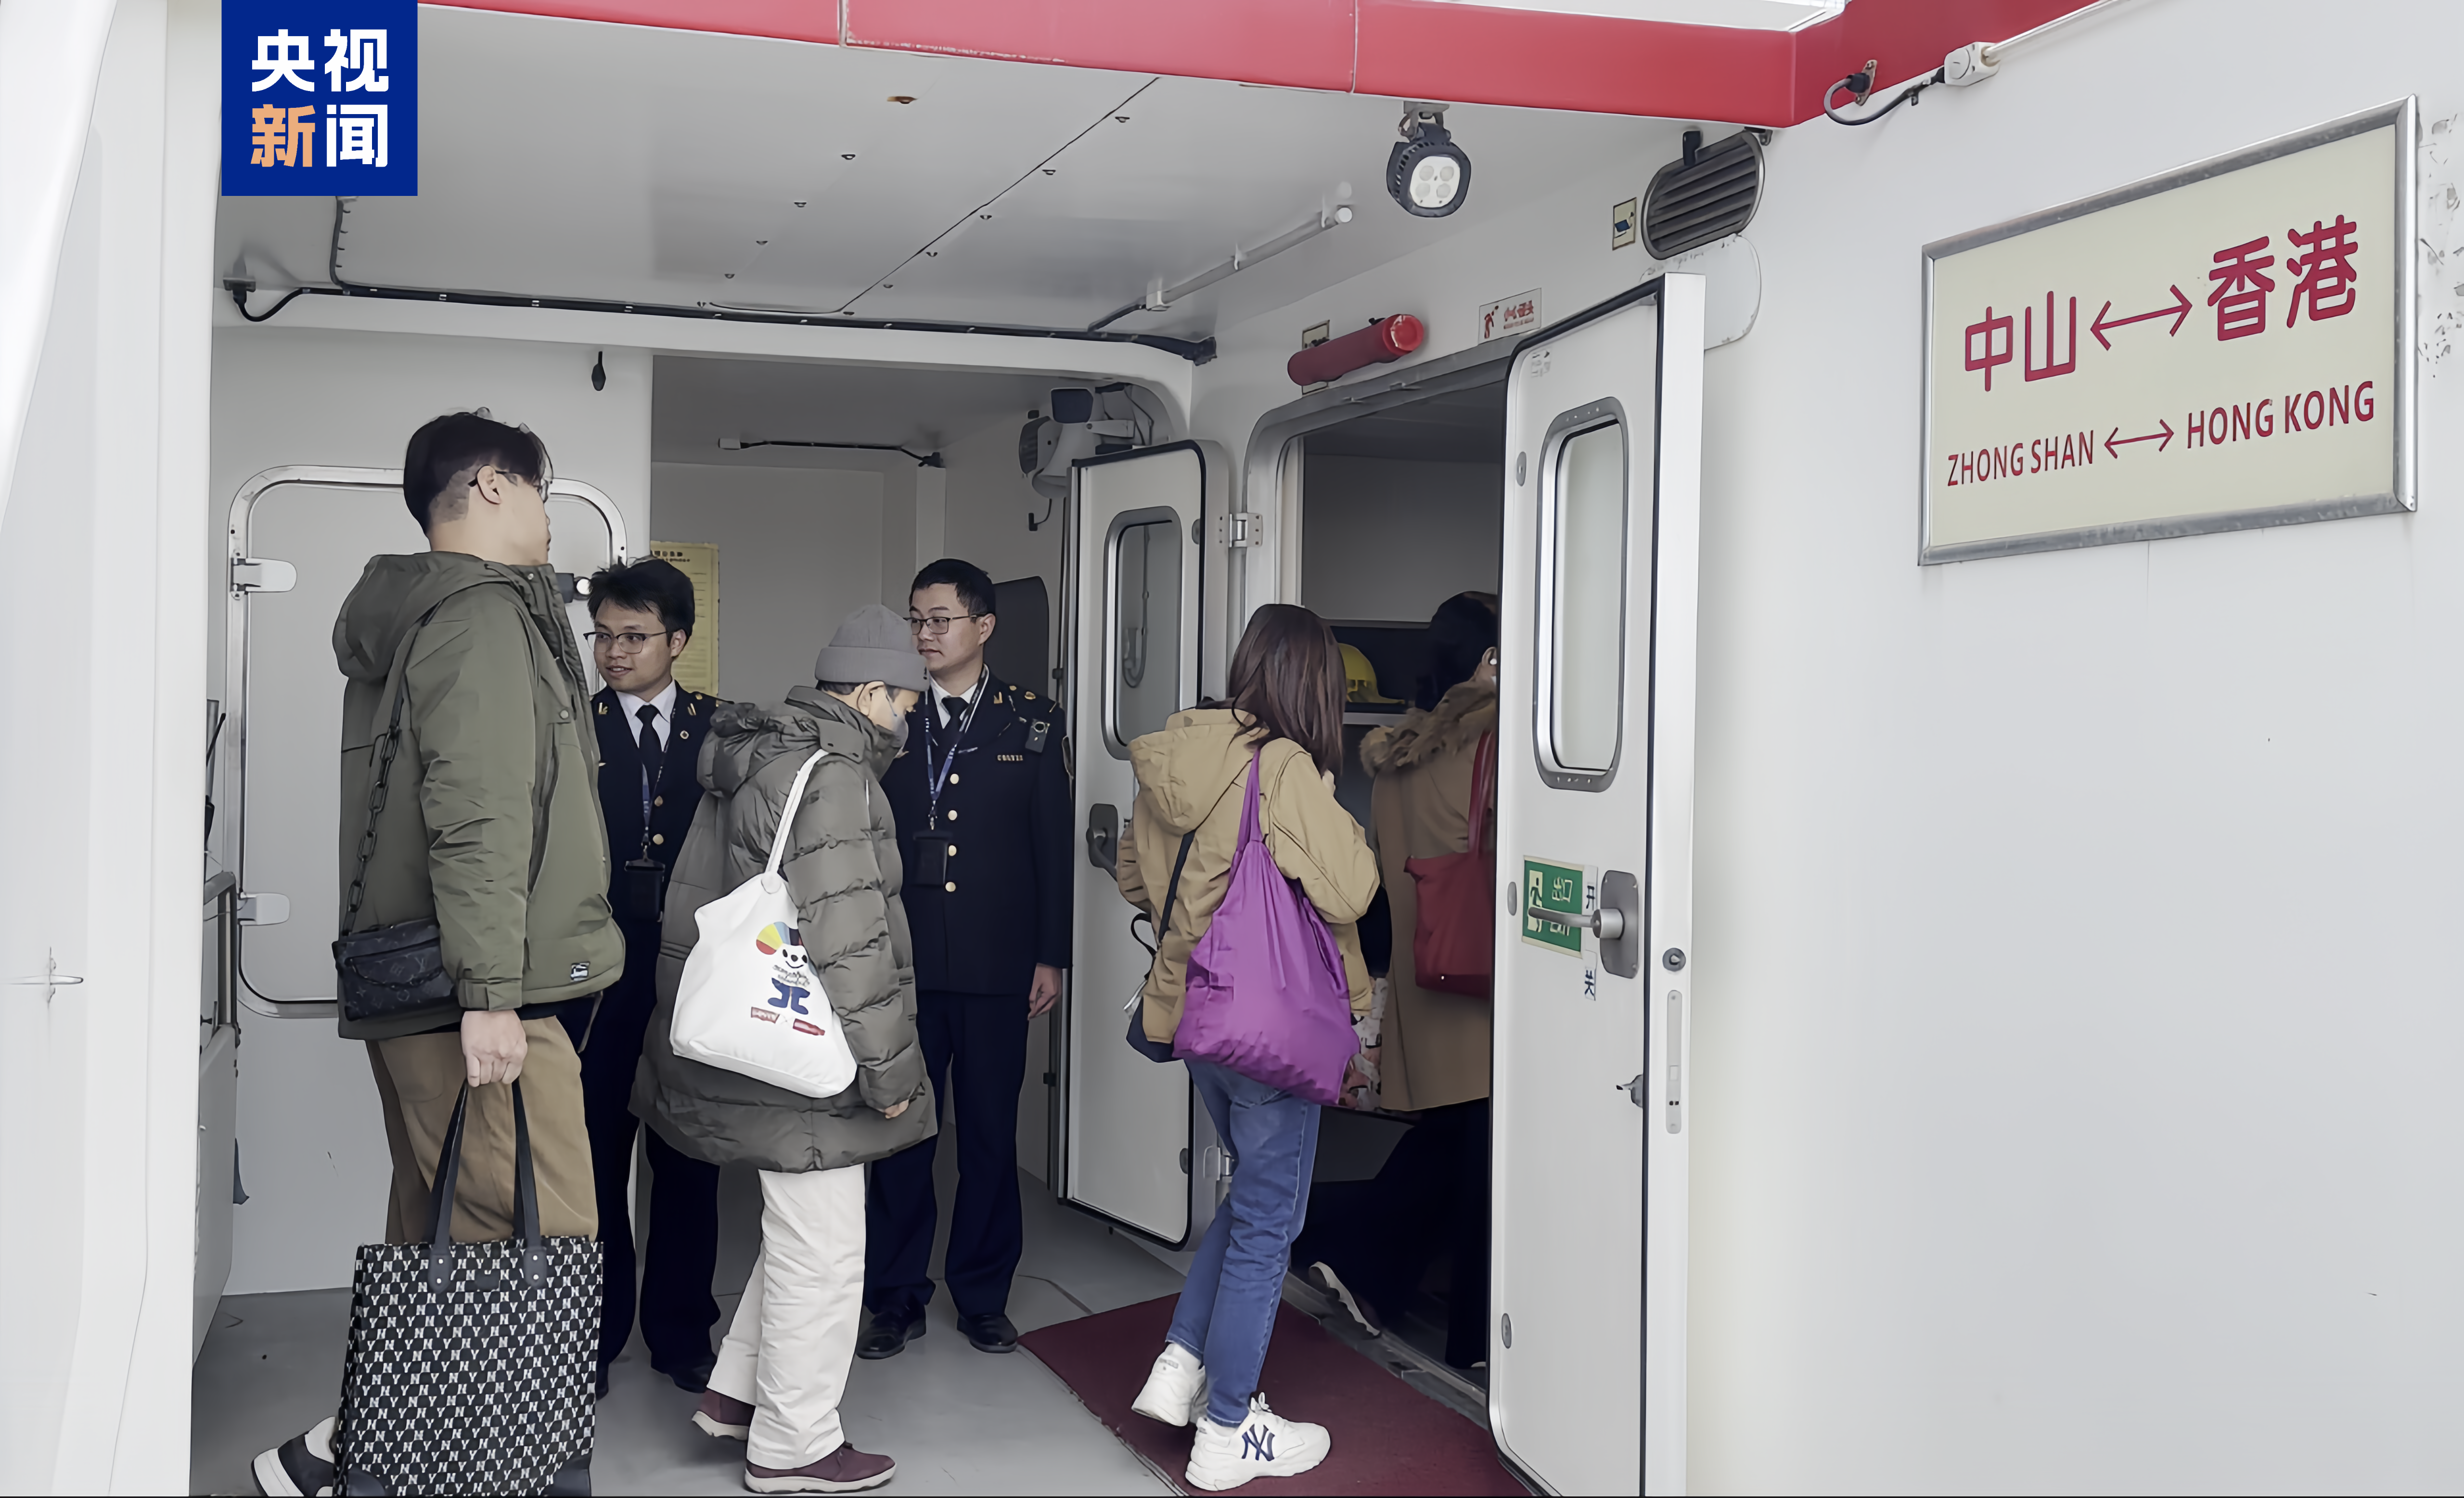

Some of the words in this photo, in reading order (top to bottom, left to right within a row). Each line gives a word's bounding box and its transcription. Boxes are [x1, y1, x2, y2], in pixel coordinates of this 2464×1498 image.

[1965, 290, 2077, 392] 中山
[2207, 215, 2359, 342] 香港
[1947, 443, 2024, 487] ZHONG
[2030, 430, 2094, 474] SHAN
[2187, 399, 2274, 449] HONG
[2284, 381, 2374, 434] KONG
